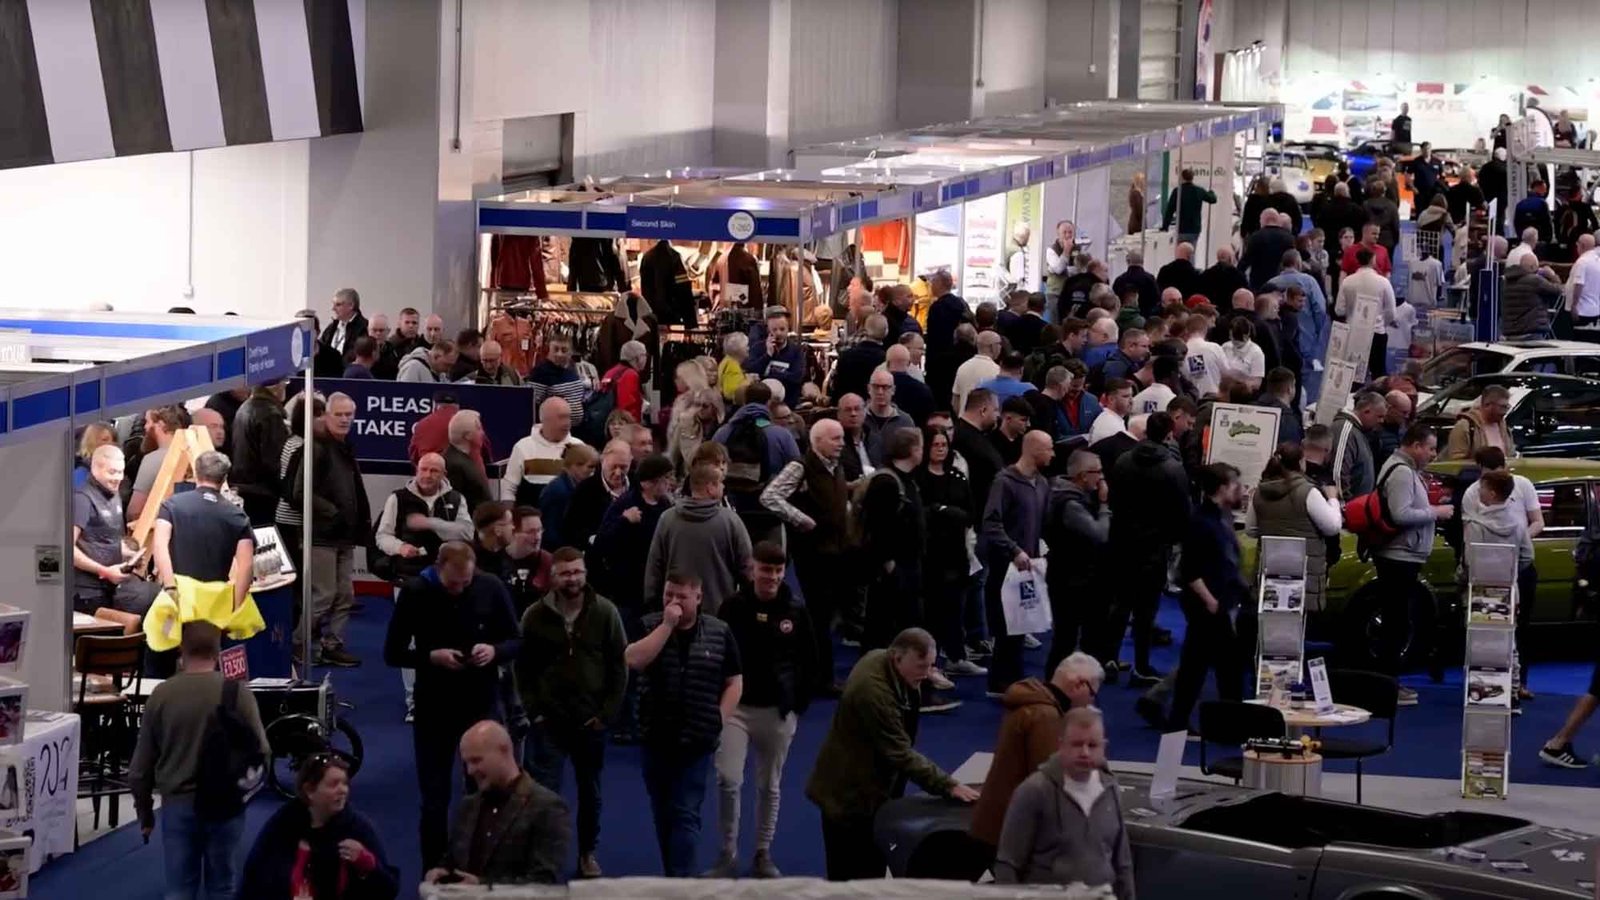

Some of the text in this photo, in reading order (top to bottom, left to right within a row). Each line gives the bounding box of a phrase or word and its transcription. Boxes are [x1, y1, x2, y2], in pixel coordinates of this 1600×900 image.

[631, 219, 677, 230] Second Skin
[367, 396, 435, 414] PLEAS
[354, 419, 406, 436] TAKE
